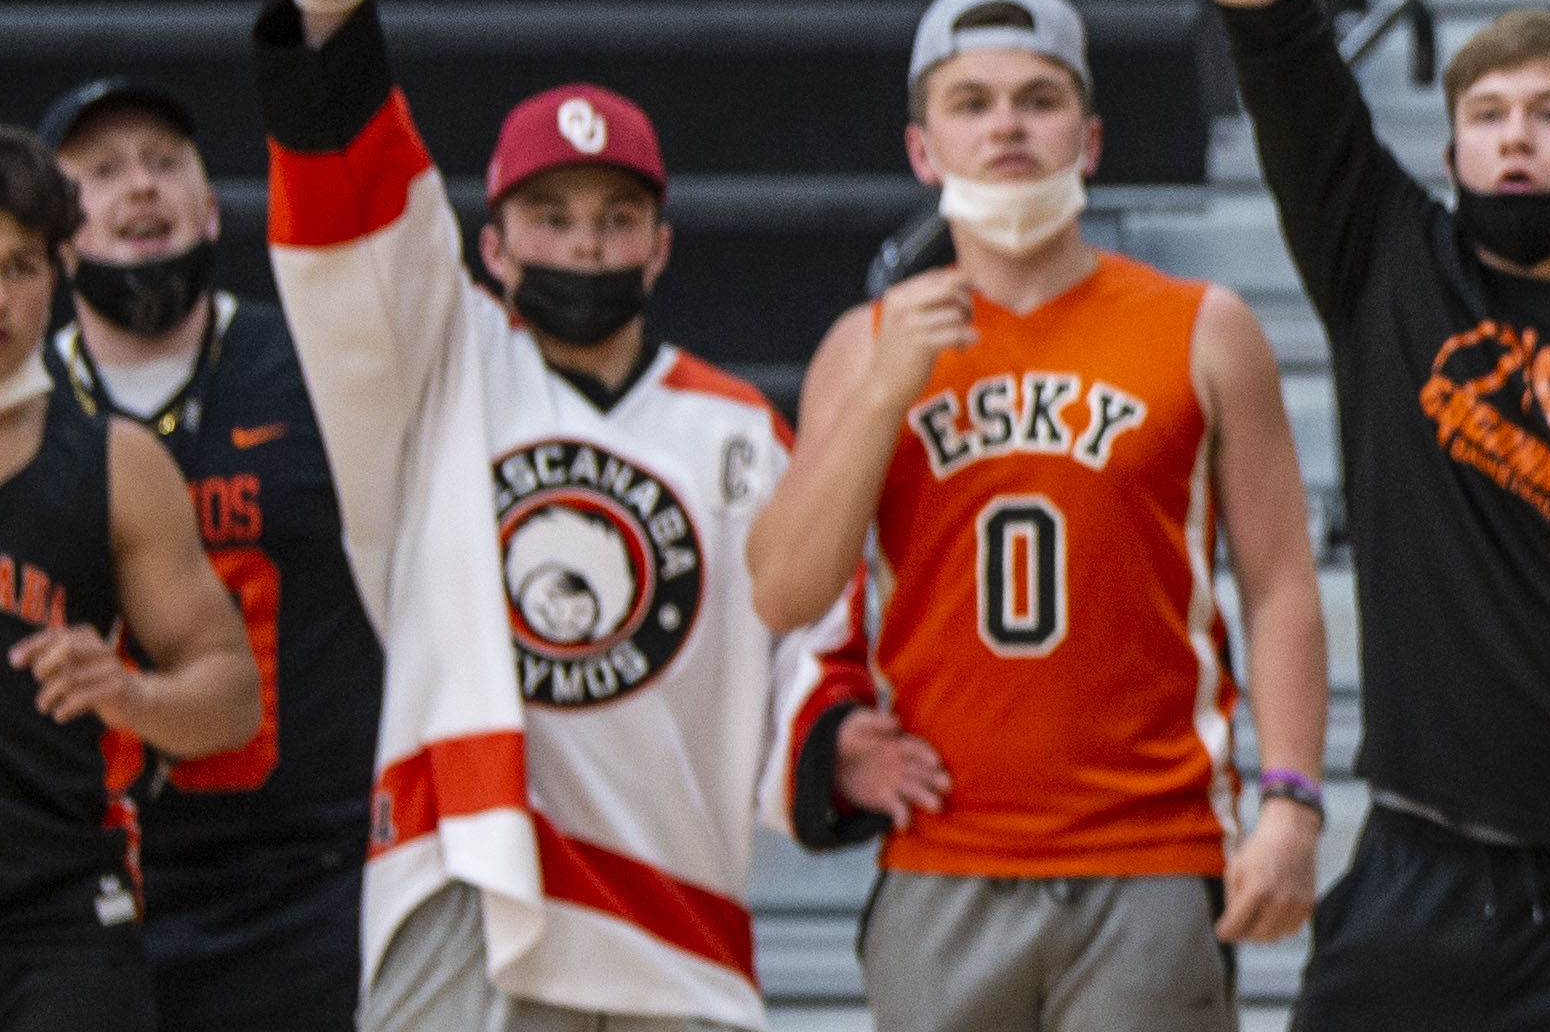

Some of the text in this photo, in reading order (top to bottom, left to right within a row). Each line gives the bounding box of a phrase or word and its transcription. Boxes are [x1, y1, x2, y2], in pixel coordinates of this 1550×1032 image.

[908, 371, 1147, 481] ESKY
[188, 474, 263, 544] OS
[976, 494, 1068, 658] 0
